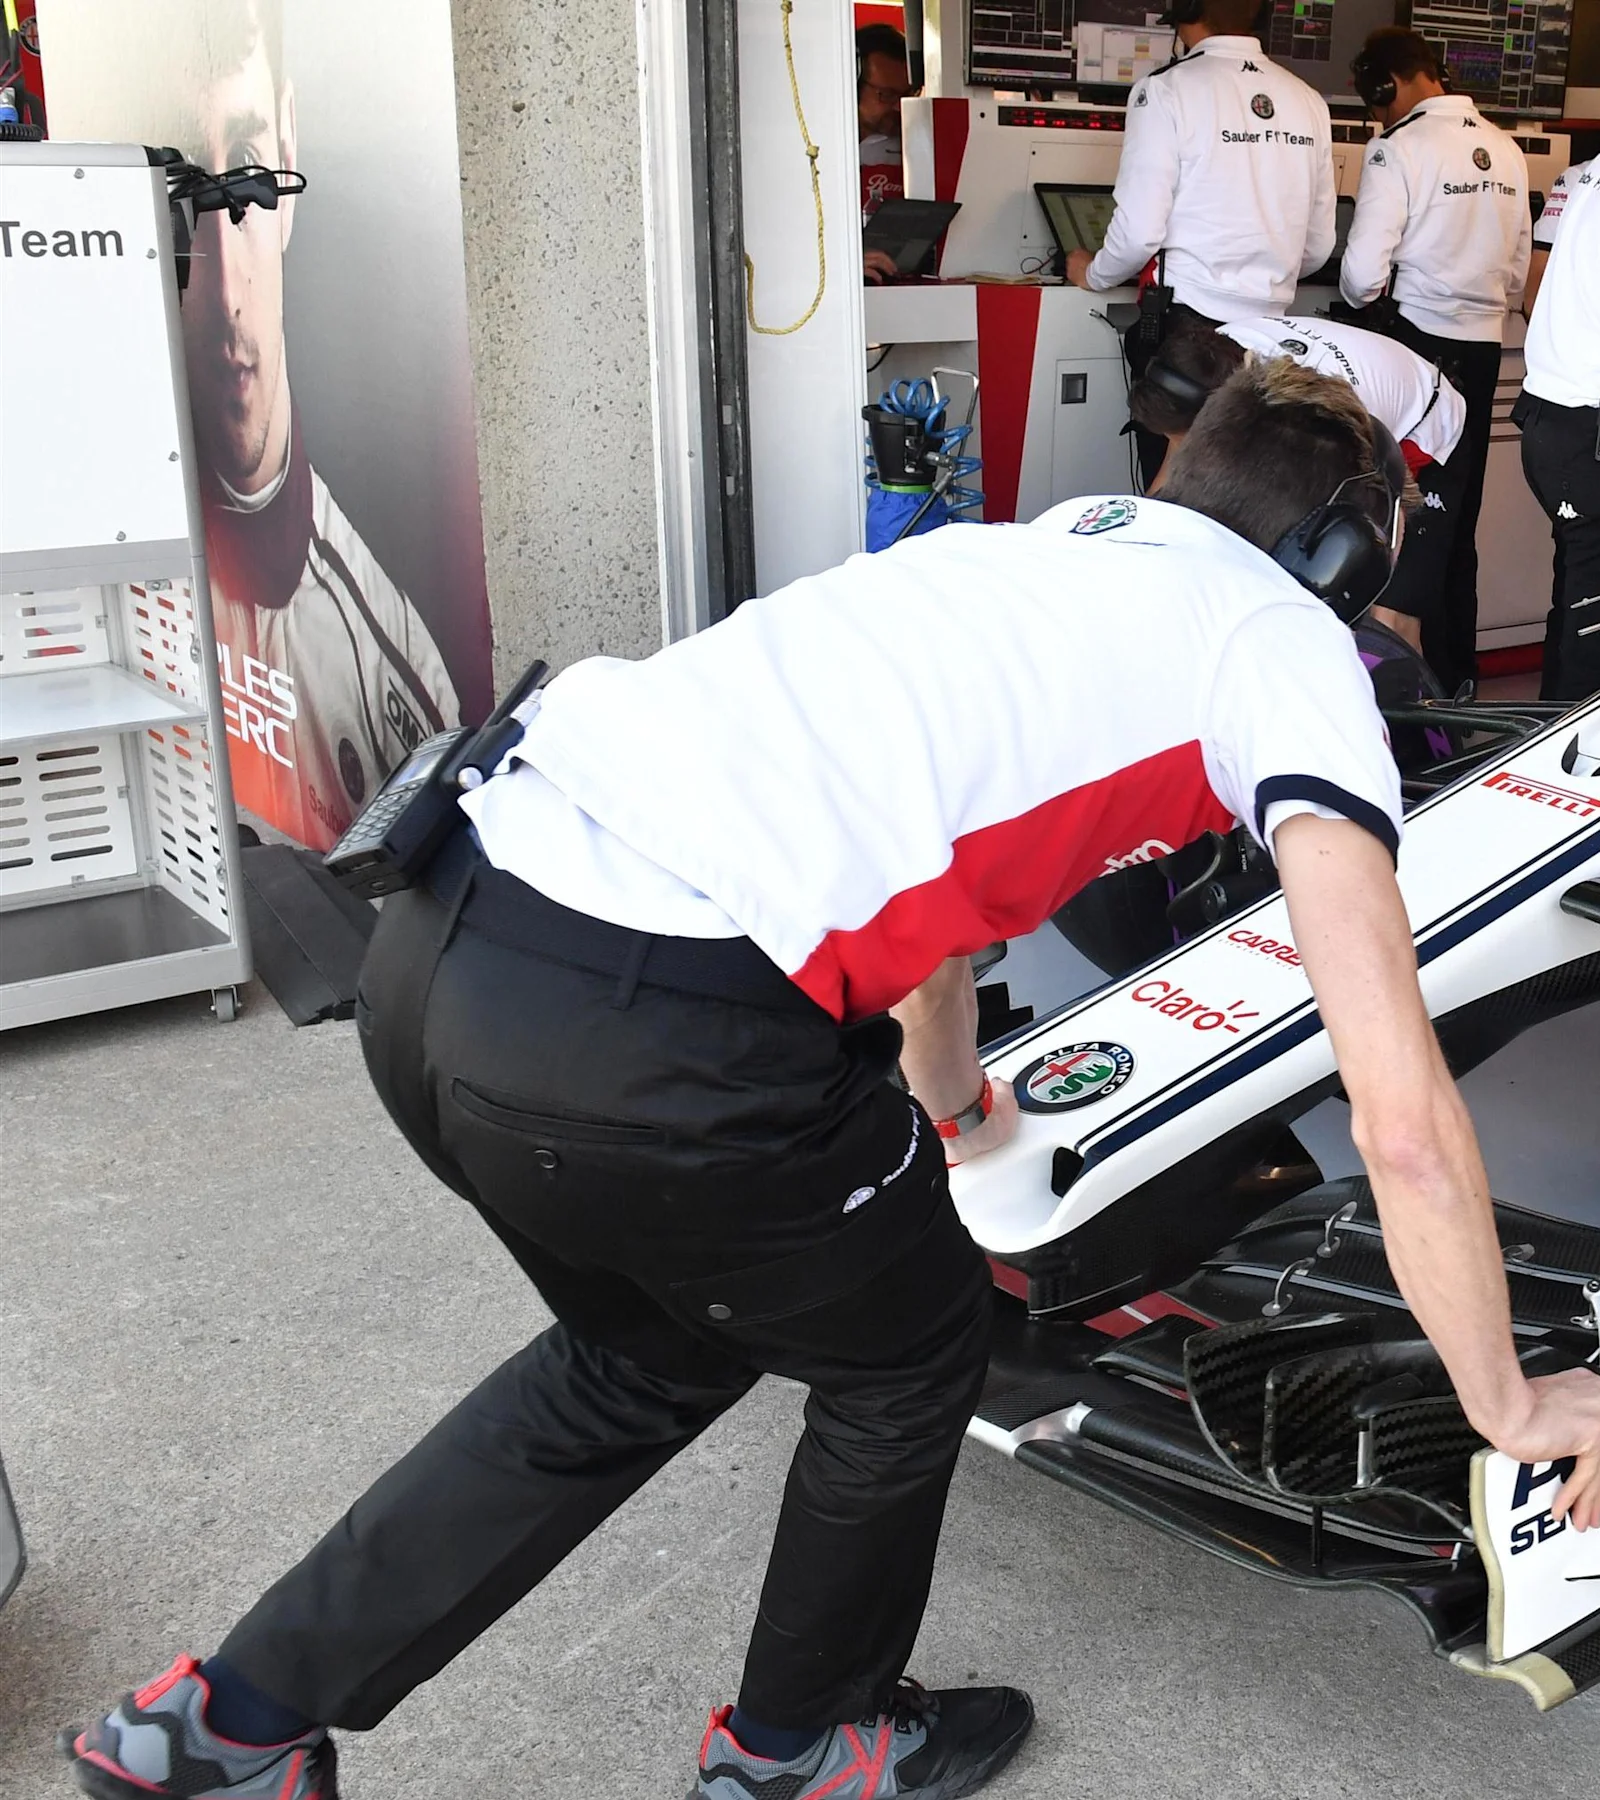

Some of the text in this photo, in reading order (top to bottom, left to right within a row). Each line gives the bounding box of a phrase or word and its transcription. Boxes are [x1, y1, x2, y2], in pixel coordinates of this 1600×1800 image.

[1282, 132, 1315, 147] Team
[1443, 182, 1479, 195] Sauber
[0, 221, 124, 258] Team
[1322, 341, 1360, 386] Sauber
[217, 641, 298, 721] LES
[387, 690, 425, 748] OM
[1131, 980, 1226, 1033] Claro
[1043, 1041, 1131, 1096] ALFA ROMEO
